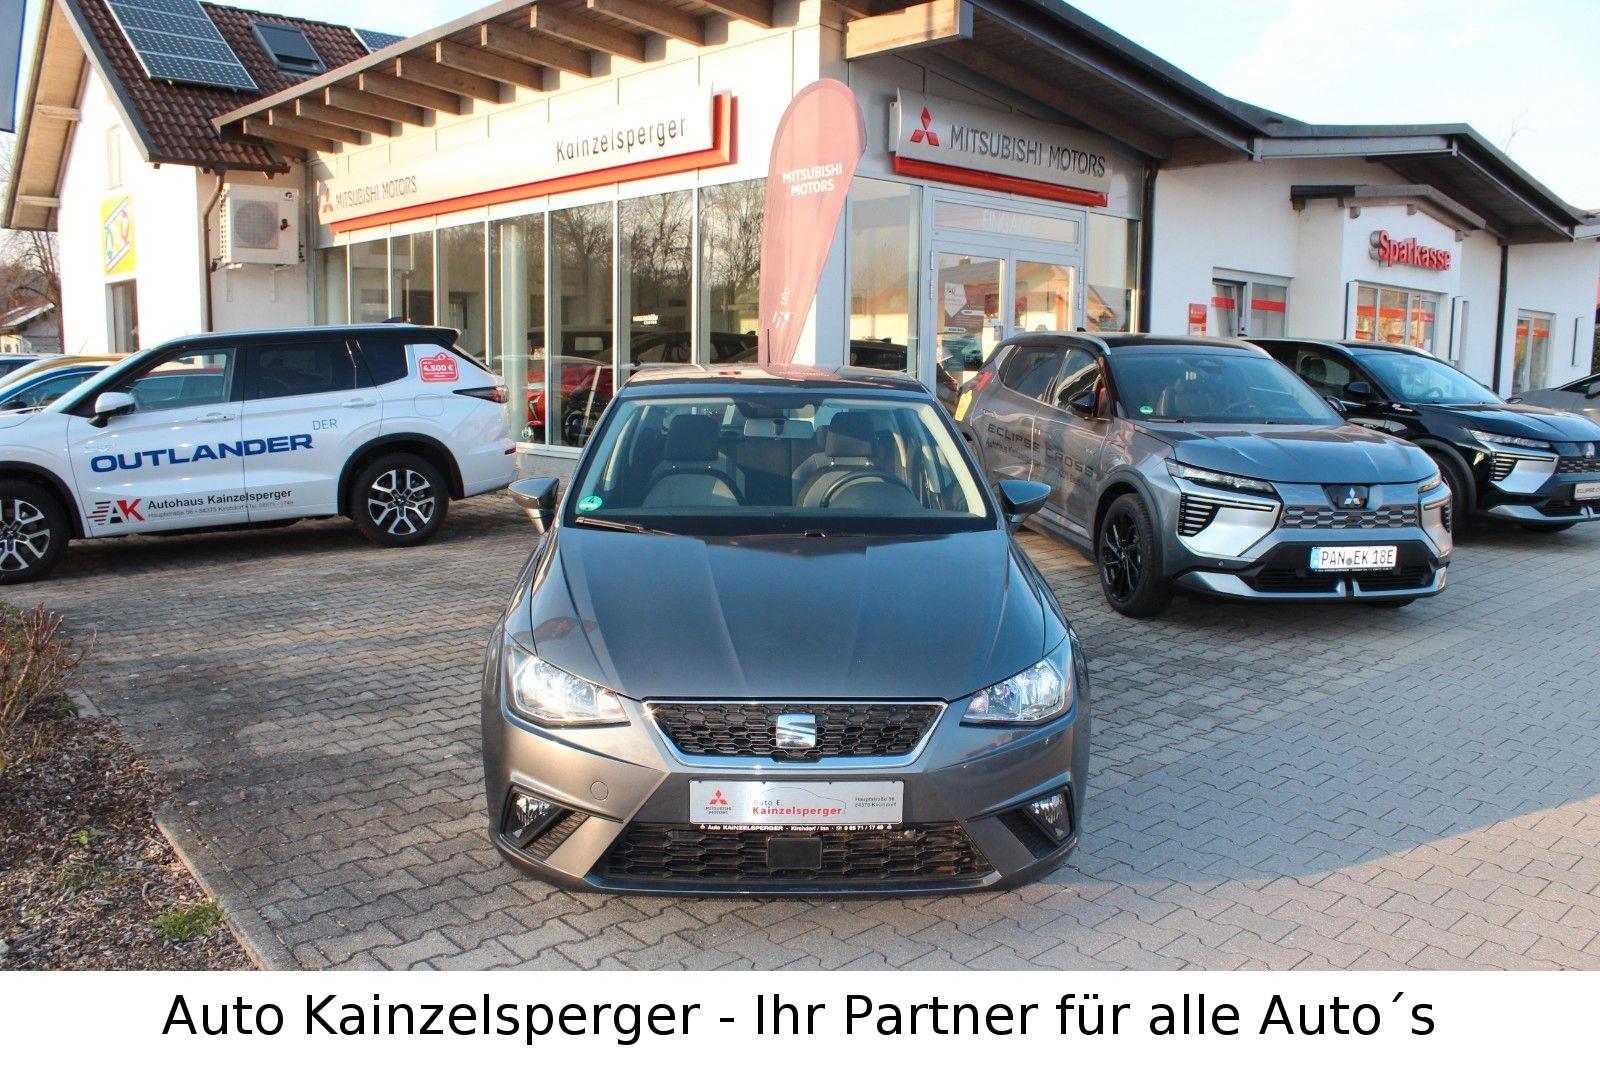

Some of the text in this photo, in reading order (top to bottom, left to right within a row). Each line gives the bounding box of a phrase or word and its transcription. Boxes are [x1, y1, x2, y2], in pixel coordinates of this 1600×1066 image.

[556, 117, 686, 162] Kainzelsperger
[950, 124, 1106, 178] MITSUBISHI MOTORS
[782, 163, 843, 184] MITSUBISHI
[335, 175, 417, 209] MITSUBISHI MOTORS
[790, 179, 836, 197] MOTORS
[1375, 229, 1452, 272] Sparkasse
[312, 418, 338, 431] DER
[90, 433, 314, 473] OUTLANDER
[987, 423, 1041, 451] ECLIPSE
[1045, 447, 1094, 477] CROSS
[148, 490, 292, 509] Autohaus Kainzelsperger
[1321, 549, 1394, 565] PAN EK 18E
[752, 806, 843, 816] Kainzelsperger
